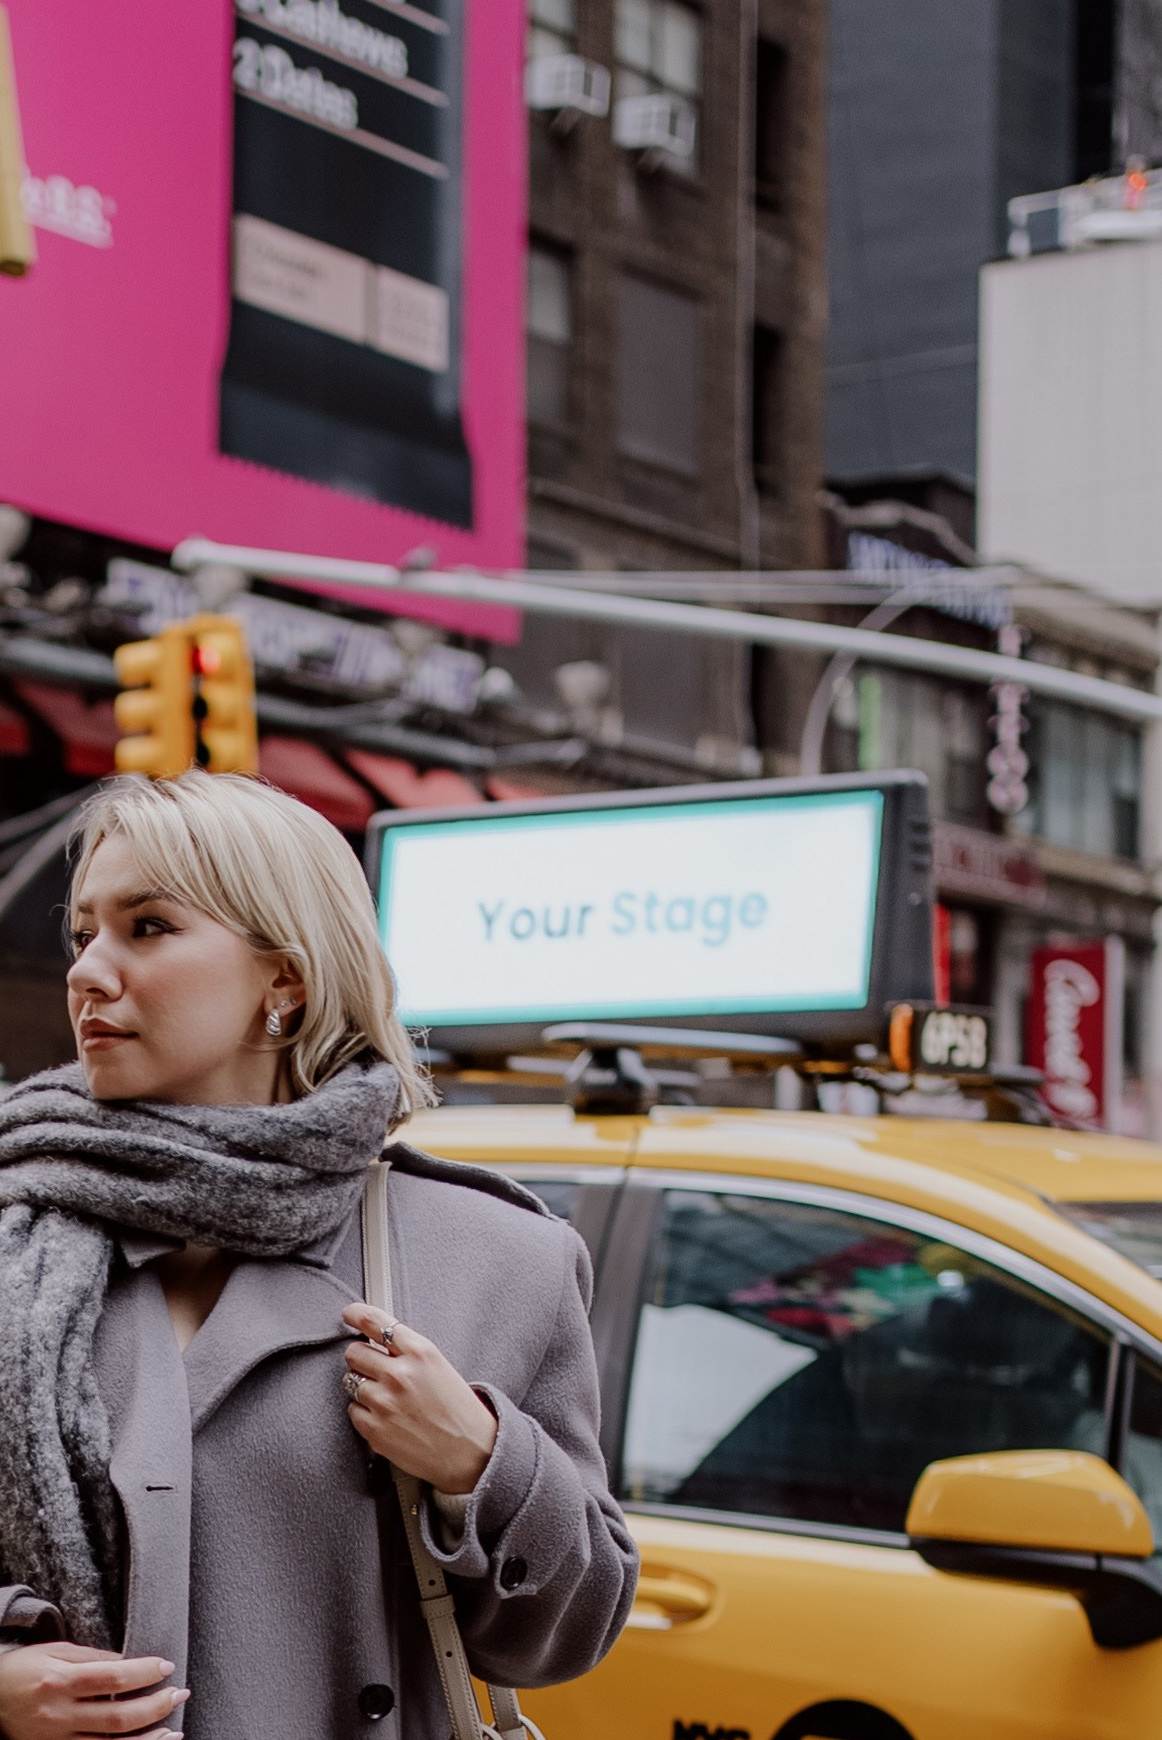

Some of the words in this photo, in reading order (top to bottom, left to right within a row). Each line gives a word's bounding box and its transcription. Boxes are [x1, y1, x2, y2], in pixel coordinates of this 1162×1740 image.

[233, 37, 262, 90] 2
[259, 43, 359, 131] Dates
[478, 899, 593, 942] Your
[610, 890, 769, 948] Stage
